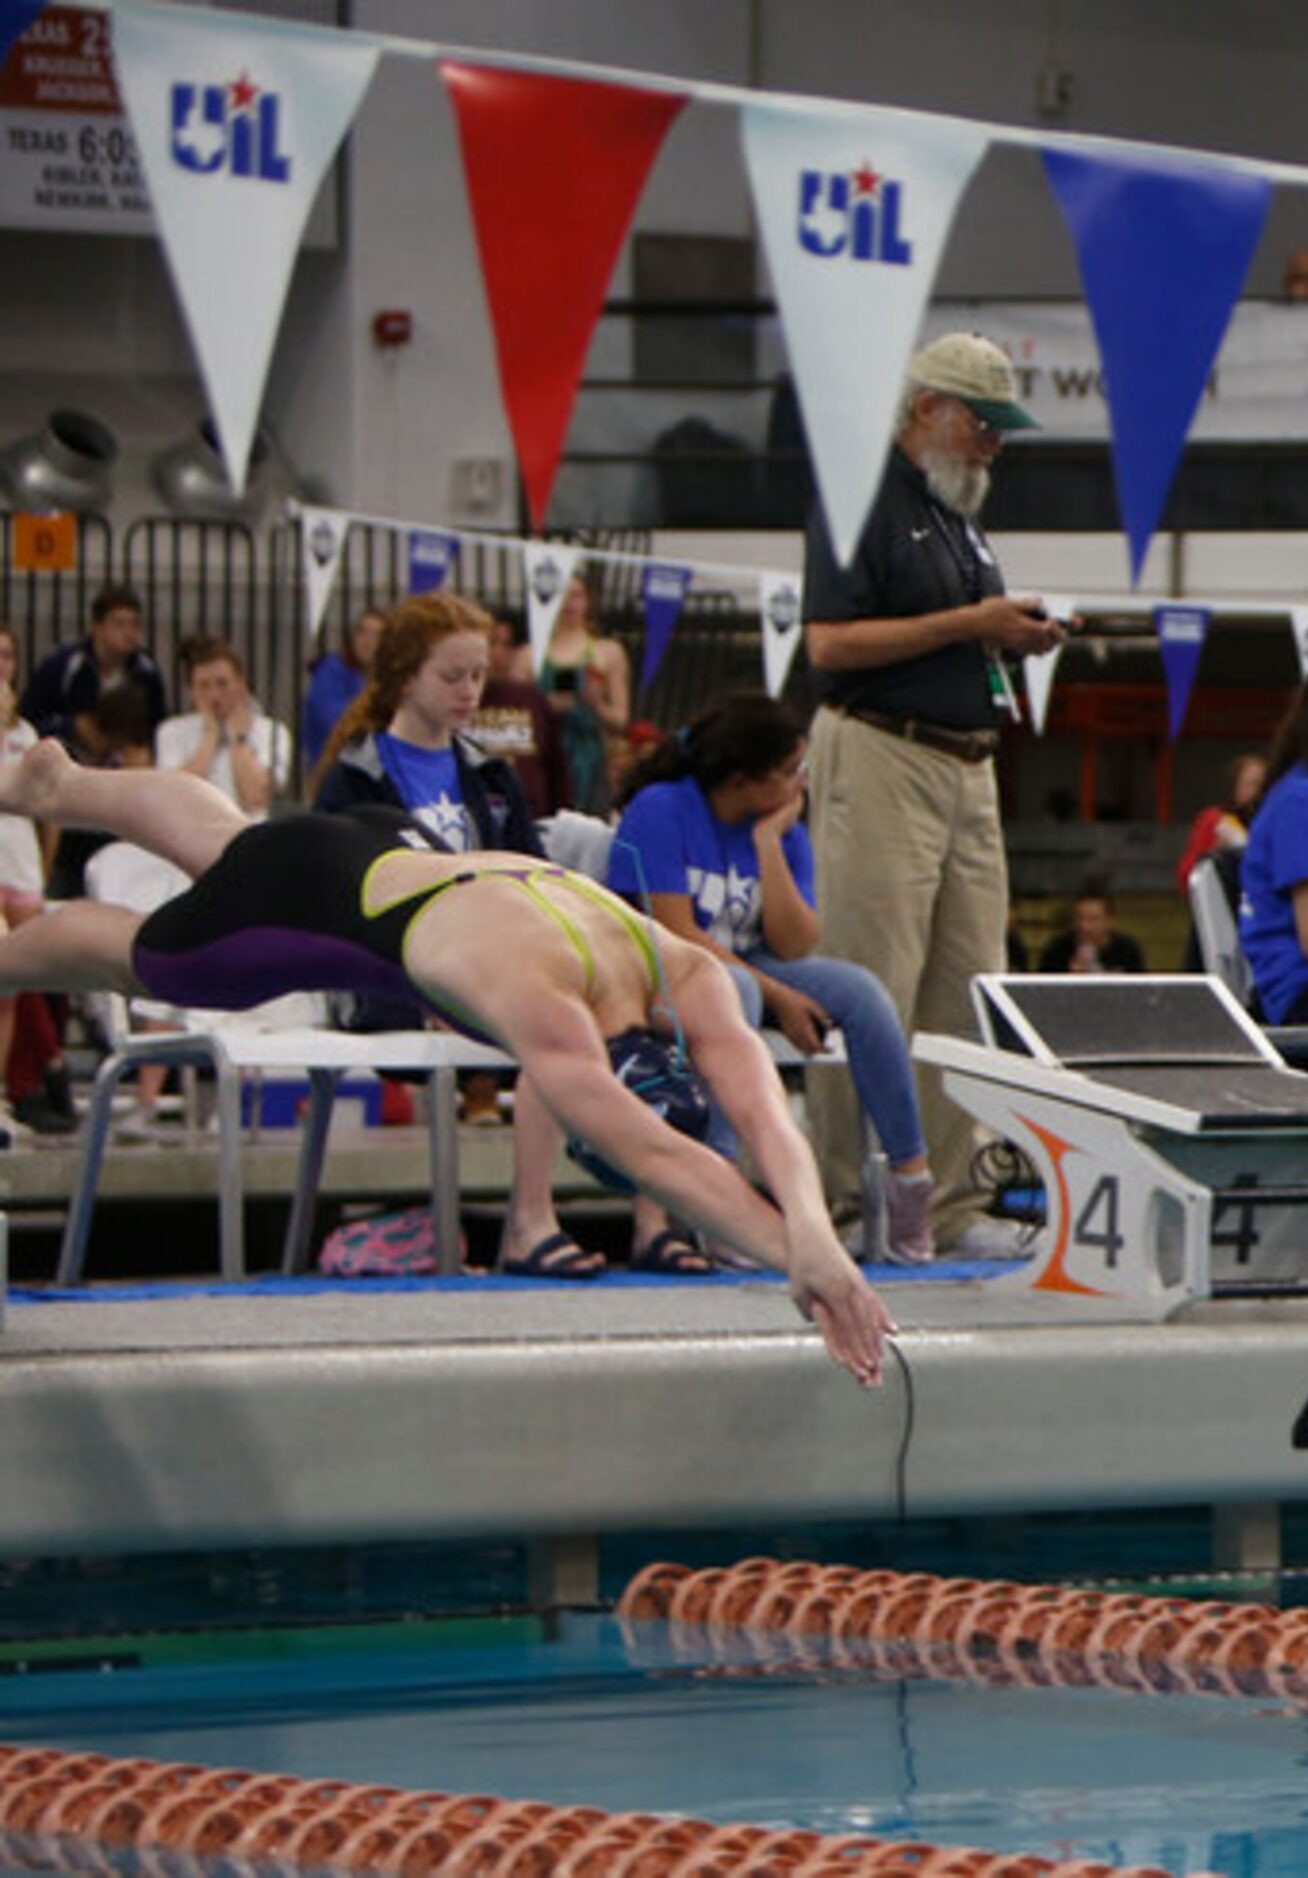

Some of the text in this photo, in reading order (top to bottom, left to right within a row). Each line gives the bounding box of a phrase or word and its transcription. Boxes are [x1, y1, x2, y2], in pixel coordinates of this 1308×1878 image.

[8, 127, 67, 153] TEXAS
[1073, 1175, 1125, 1269] 4
[1211, 1172, 1260, 1266] 4
